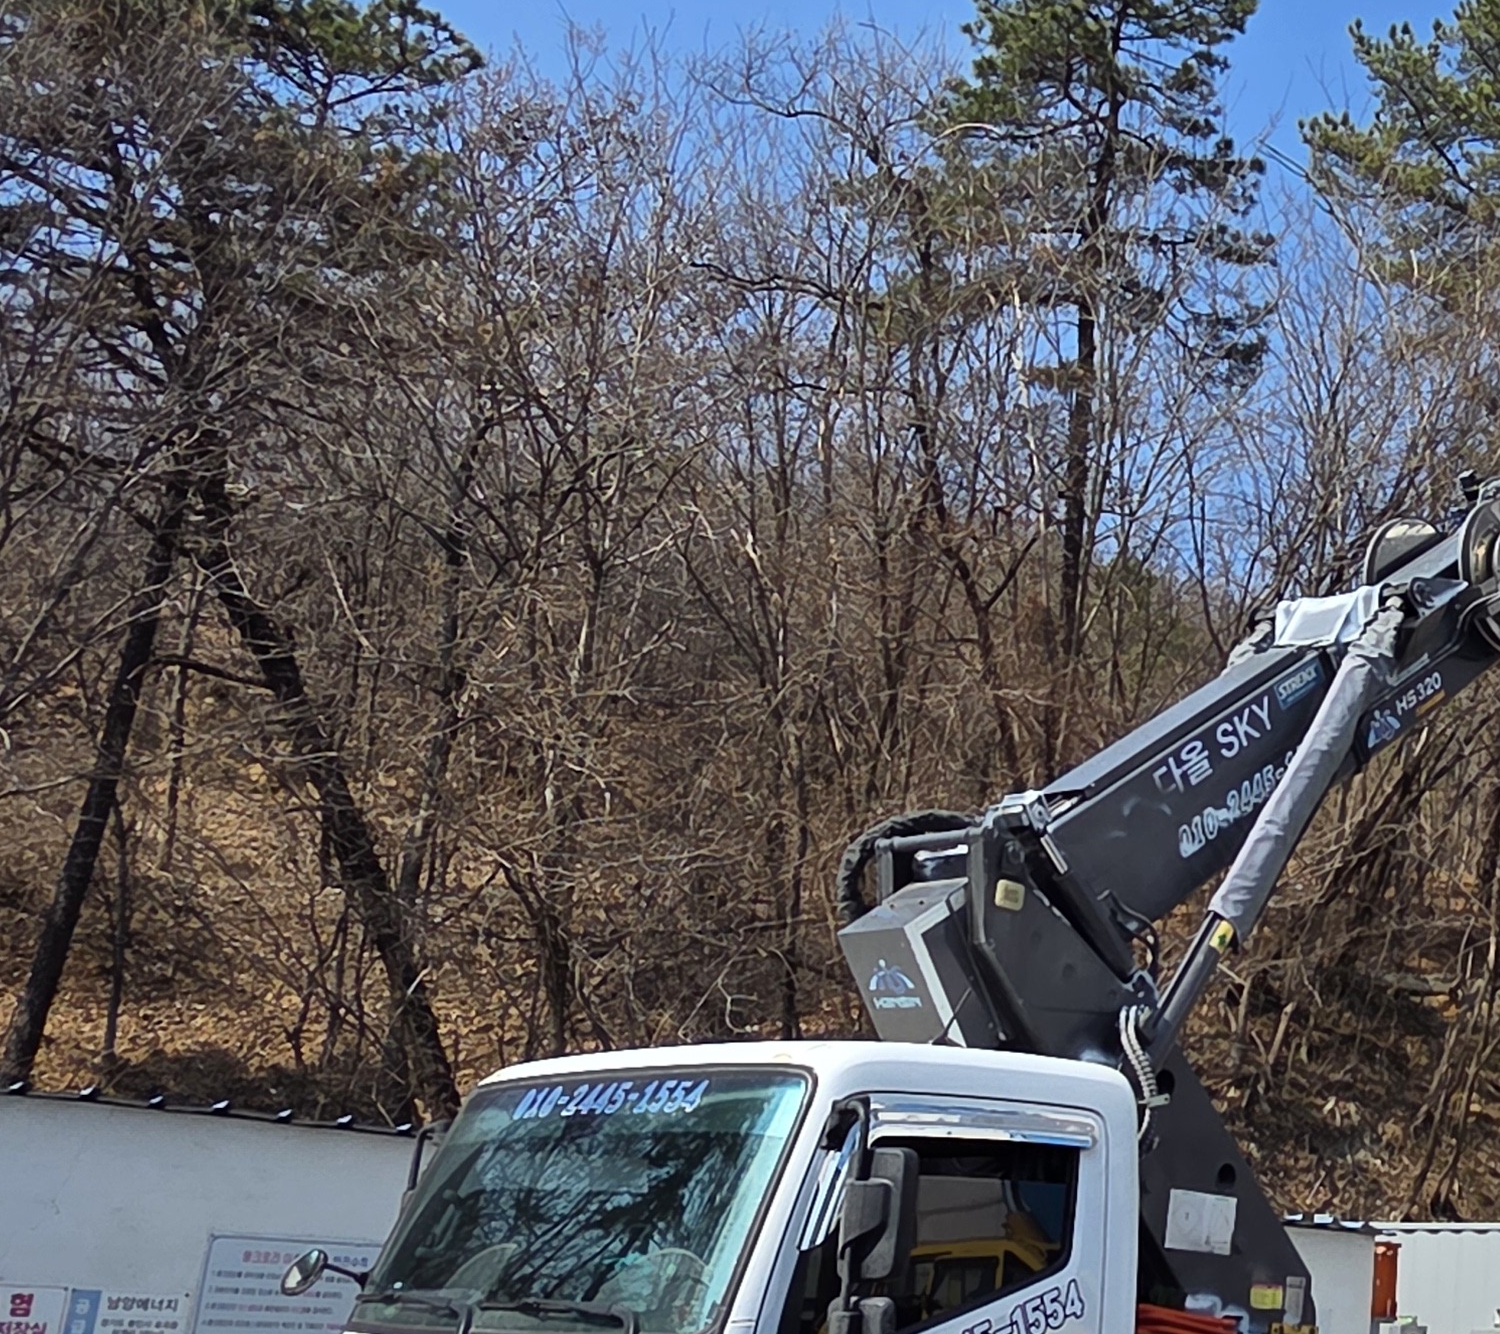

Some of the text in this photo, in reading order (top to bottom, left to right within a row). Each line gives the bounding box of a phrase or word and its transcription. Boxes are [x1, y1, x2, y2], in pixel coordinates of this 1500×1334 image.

[1152, 695, 1272, 793] 다올 SKY
[512, 1079, 710, 1120] 010-2445-1554
